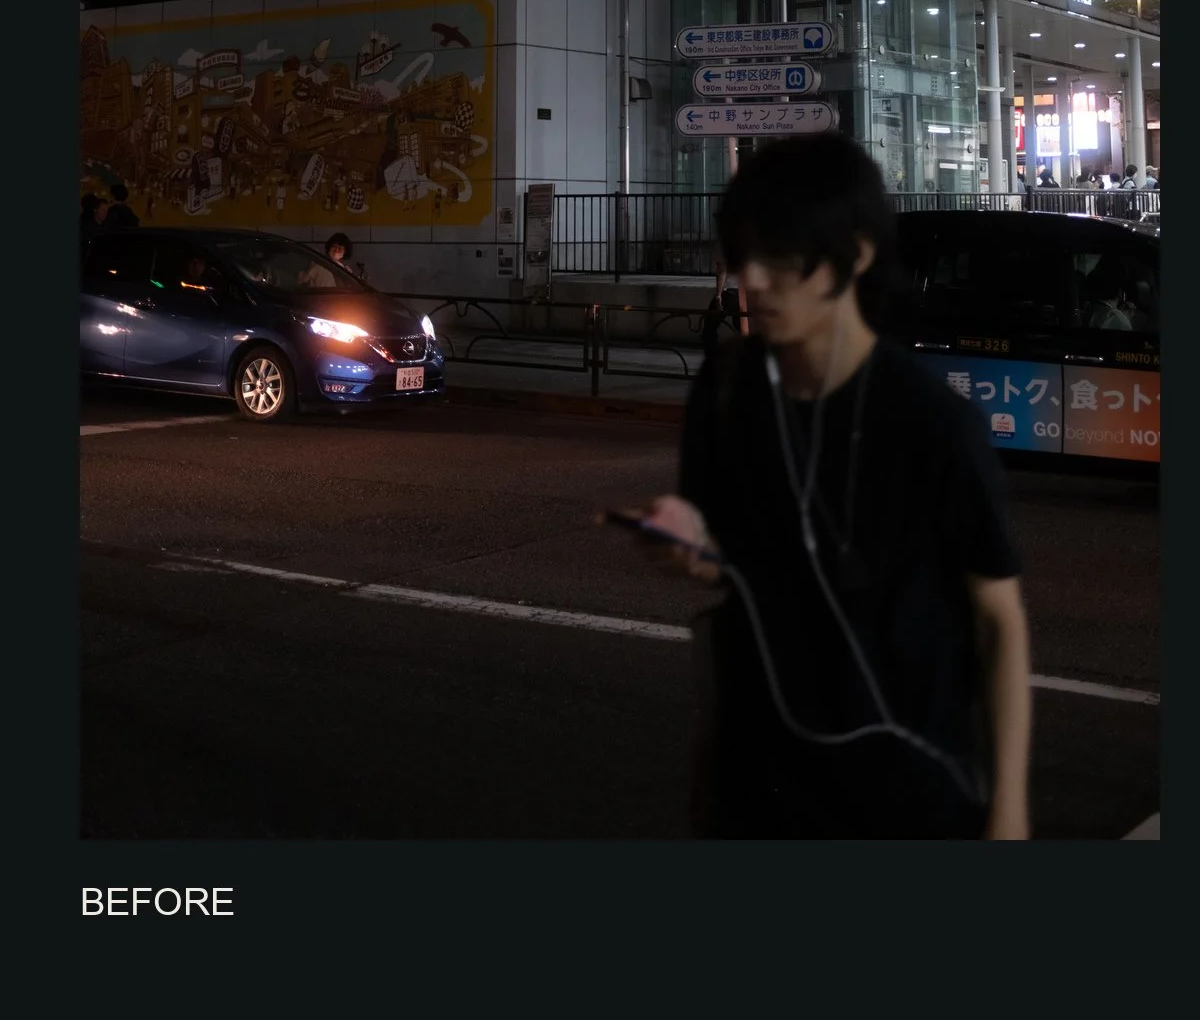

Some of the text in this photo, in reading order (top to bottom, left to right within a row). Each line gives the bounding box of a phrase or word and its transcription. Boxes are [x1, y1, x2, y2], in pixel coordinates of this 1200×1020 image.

[707, 28, 799, 43] 東京都第三建設事務所
[685, 46, 703, 54] 190m
[725, 69, 782, 82] 中野区役所
[750, 84, 761, 93] City
[709, 108, 823, 122] 中野サンプラザ
[984, 338, 1009, 351] 326
[1115, 351, 1151, 364] SHINTO
[1033, 421, 1061, 437] GO
[1066, 424, 1124, 444] beyond
[1130, 429, 1160, 447] NO
